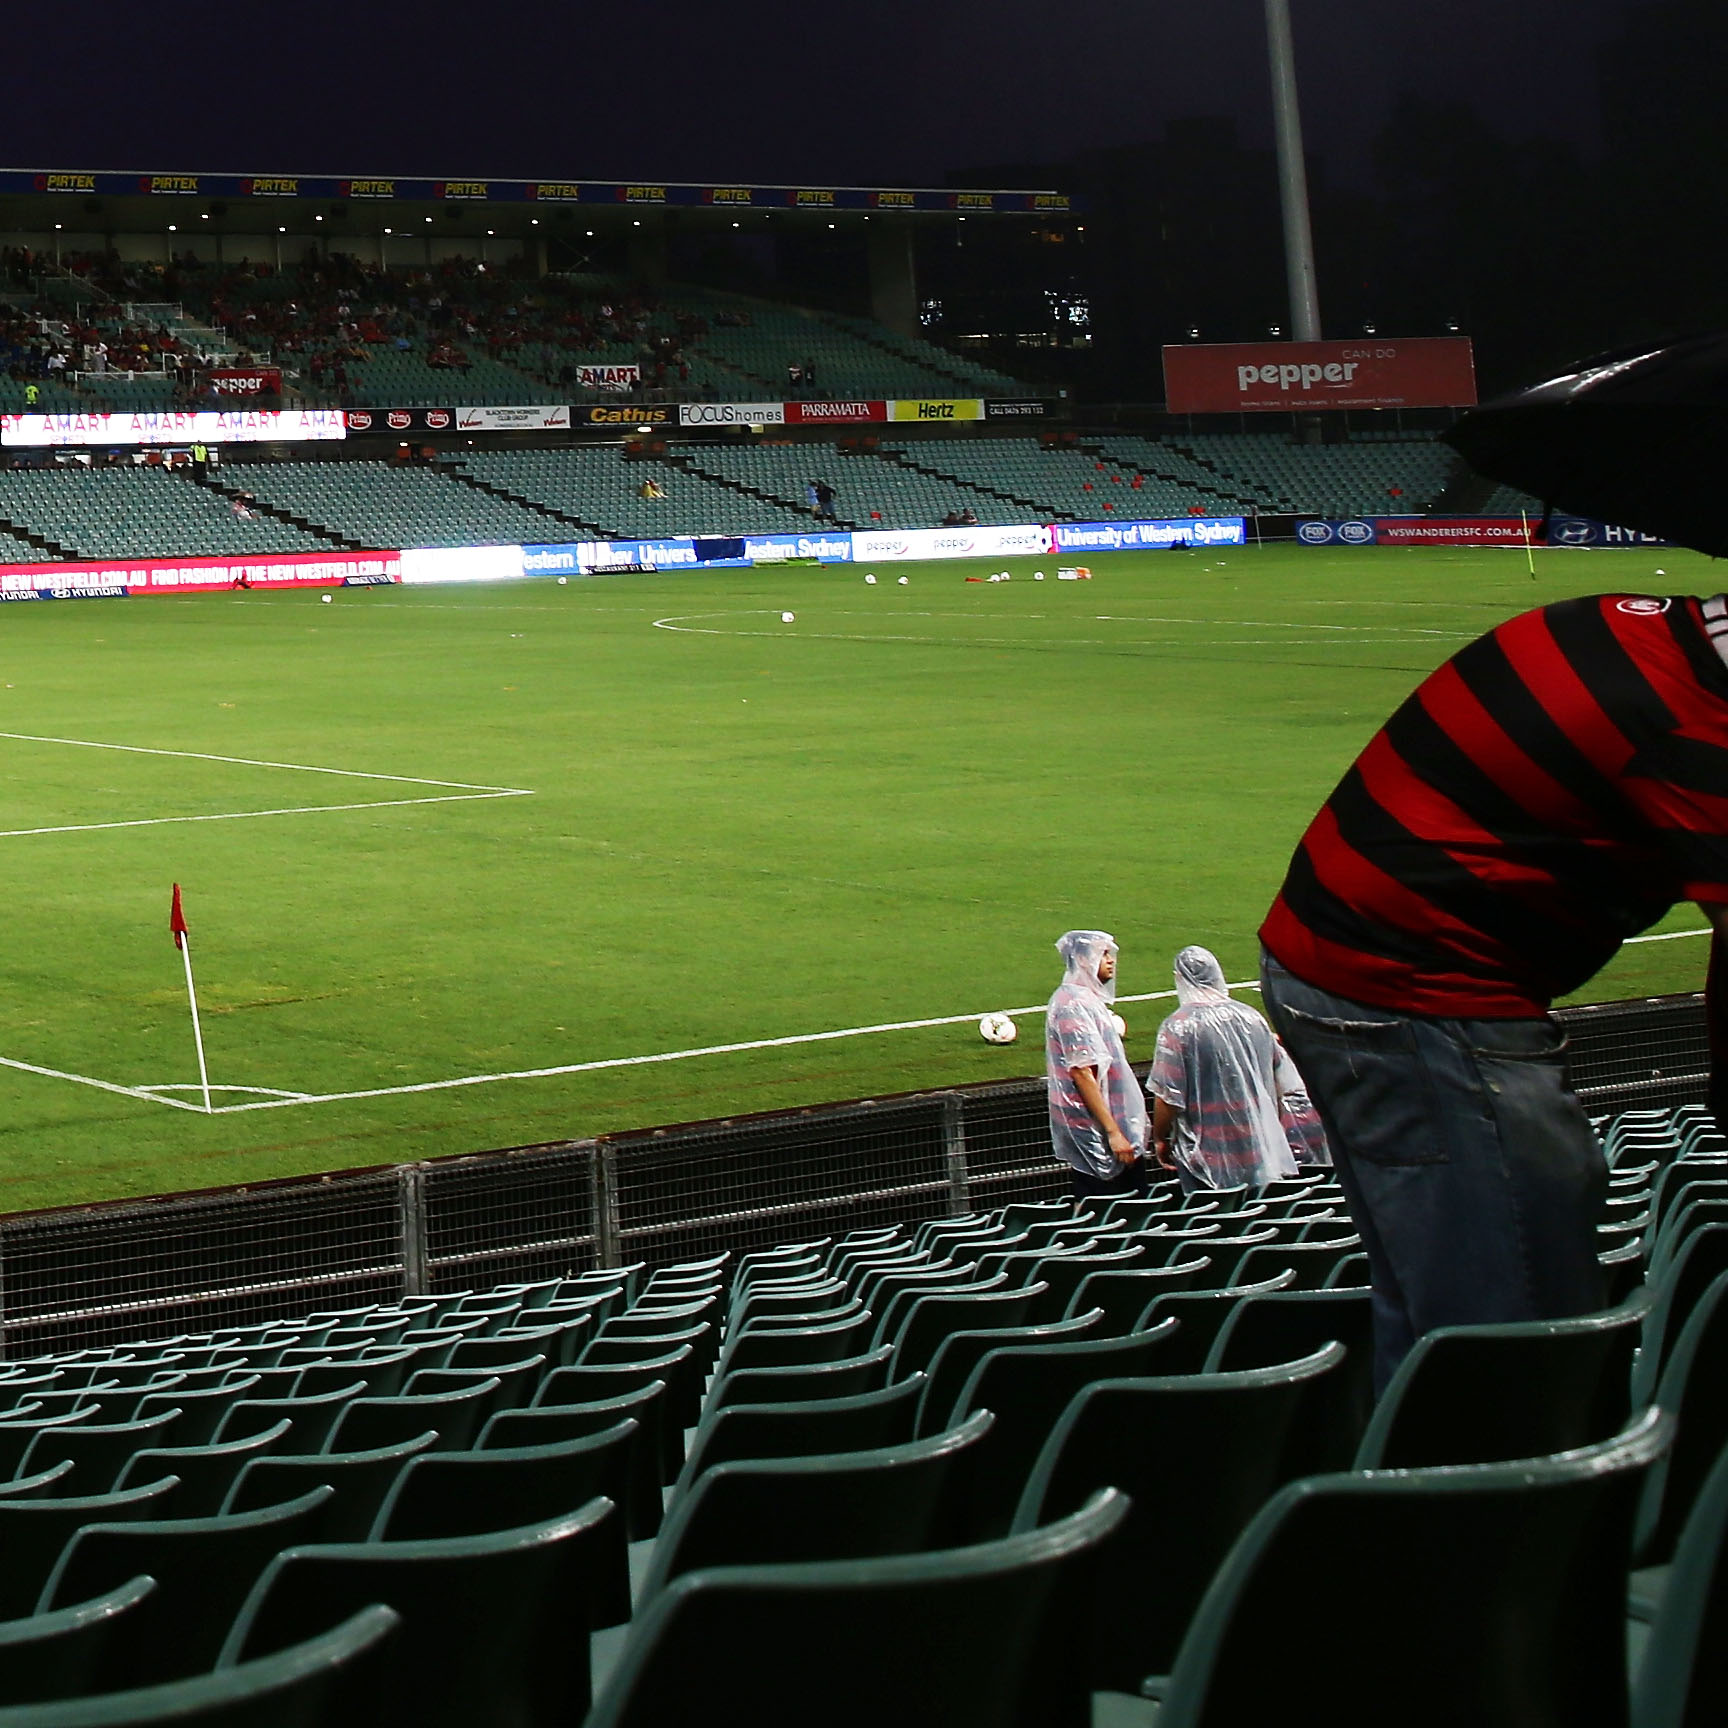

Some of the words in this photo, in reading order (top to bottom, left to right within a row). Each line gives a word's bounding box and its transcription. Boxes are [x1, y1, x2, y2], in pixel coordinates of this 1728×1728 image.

[49, 177, 94, 188] PIRTEK
[153, 178, 197, 190] PIRTEK
[255, 181, 297, 192] PIRTEK
[353, 183, 393, 193] PIRTEK
[447, 185, 486, 195] PIRTEK
[539, 187, 577, 196] PIRTEK
[628, 189, 665, 198] PIRTEK
[715, 191, 750, 201] PIRTEK
[799, 193, 833, 202] PIRTEK
[880, 195, 913, 203] PIRTEK
[960, 196, 991, 205] PIRTEK
[1037, 197, 1069, 205] PIRTEK
[1341, 349, 1371, 360] CAN
[1375, 347, 1396, 359] DO
[581, 368, 639, 384] AMART
[1237, 361, 1359, 391] pepper
[590, 407, 666, 423] Cathis
[680, 404, 782, 424] FOCUShomes
[801, 403, 870, 416] PARRAMATTA
[918, 403, 954, 419] Hertz
[42, 414, 110, 432] AMART
[129, 413, 197, 431] AMART
[215, 412, 279, 430] AMART
[347, 414, 372, 426] Primo
[386, 414, 411, 426] Primo
[425, 413, 449, 425] Primo
[1056, 527, 1122, 548] University
[1122, 525, 1138, 544] of
[1138, 524, 1193, 543] Western
[1194, 521, 1240, 544] Sydney
[1305, 526, 1327, 537] FOX
[1344, 526, 1366, 536] FOX
[638, 543, 698, 564] Univers
[797, 537, 850, 560] Sydney
[151, 569, 179, 586] FIND
[179, 567, 229, 584] FASHION
[244, 565, 270, 582] THE
[268, 564, 296, 581] NEW
[295, 560, 401, 580] WESTFIELD.COM.AU
[1, 574, 32, 592] NEW
[32, 570, 148, 590] WESTFIELD.COM.AU
[73, 586, 124, 597] HYUNDAI
